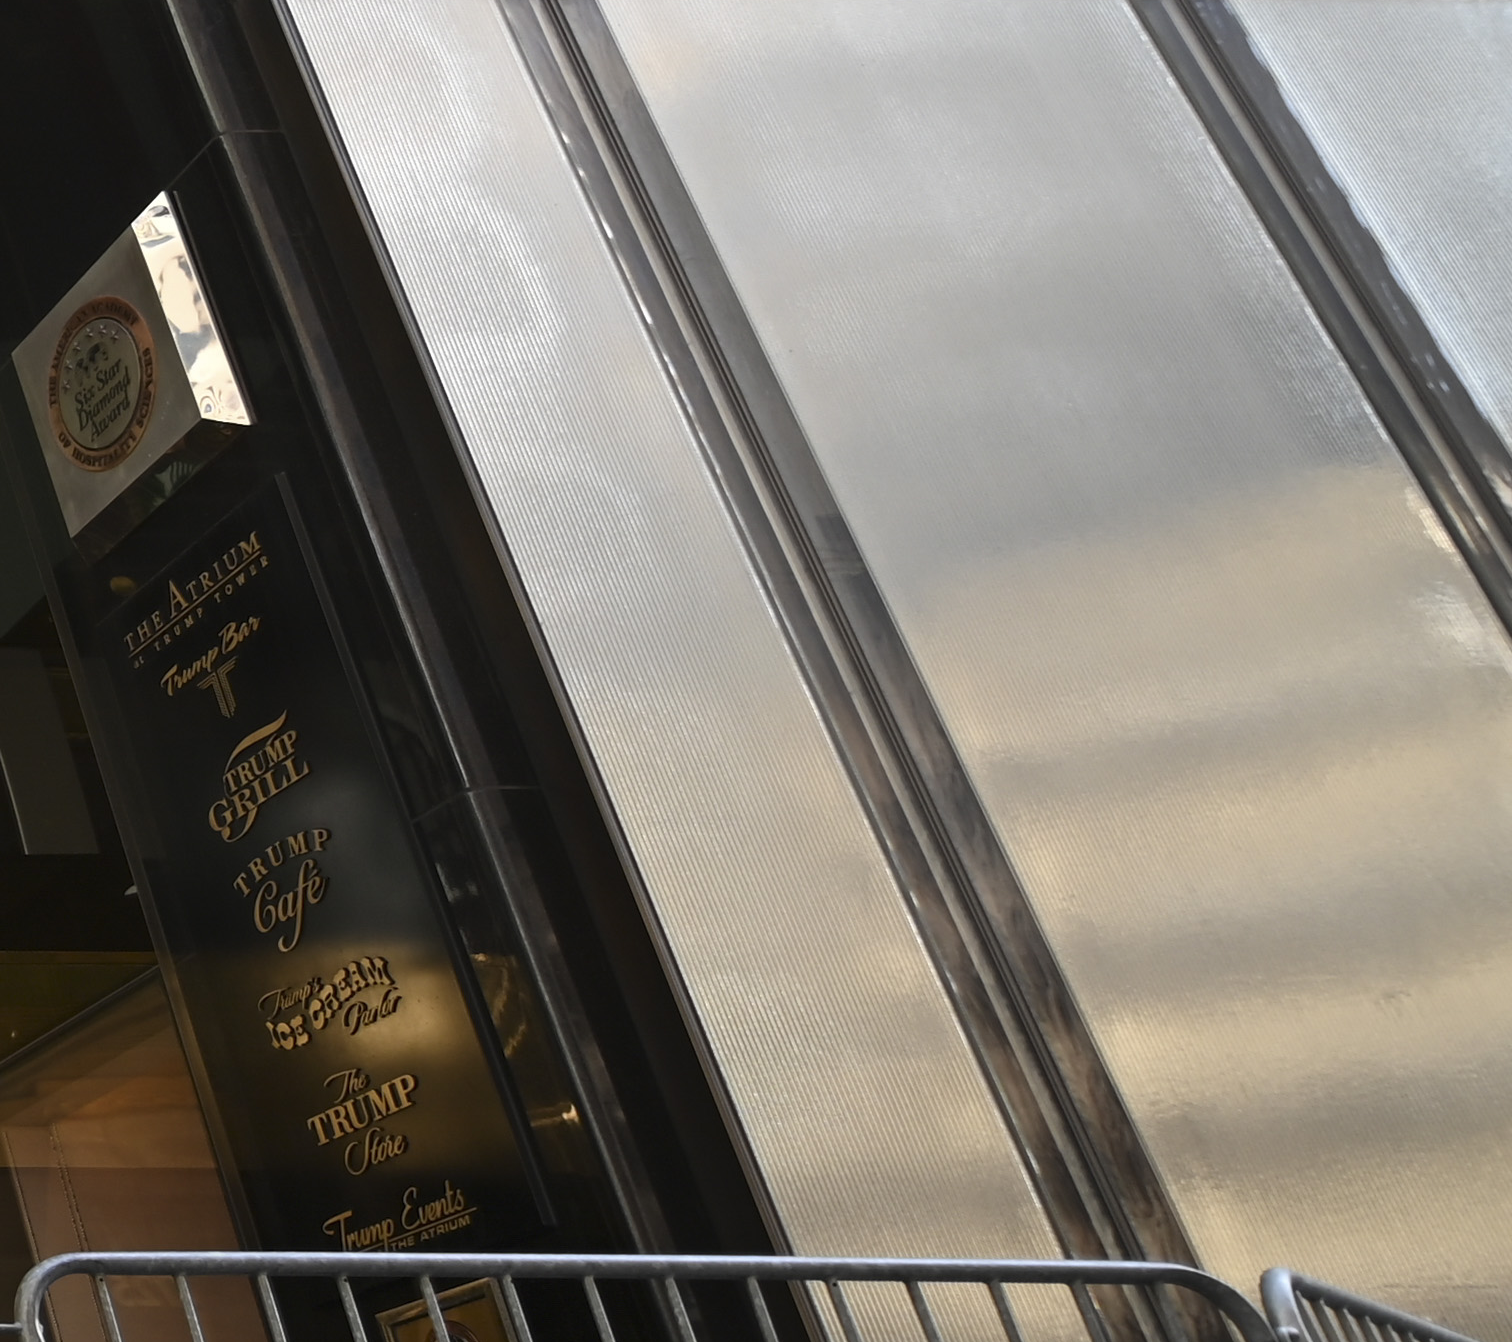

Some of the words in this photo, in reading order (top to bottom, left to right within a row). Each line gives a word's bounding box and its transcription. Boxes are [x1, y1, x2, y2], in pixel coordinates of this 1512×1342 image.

[123, 611, 163, 651] THE
[169, 530, 262, 619] ATRIUM
[154, 607, 203, 651] TRUMP
[214, 556, 269, 603] TOWER
[160, 646, 219, 696] Trump
[218, 616, 261, 655] Bar
[223, 716, 298, 795] TRUMP
[208, 755, 311, 843] GRILL
[232, 828, 330, 898] TRUMP
[253, 858, 327, 953] Café
[258, 977, 323, 1020] Trump's
[265, 1014, 310, 1050] ICE
[309, 956, 395, 1031] CREAM
[342, 987, 402, 1036] Parlor
[307, 1074, 417, 1147] TRUMP
[324, 1068, 366, 1104] The
[344, 1127, 407, 1176] Store
[322, 1210, 395, 1253] Trump
[401, 1179, 466, 1230] Events
[390, 1237, 415, 1252] THE
[420, 1214, 470, 1243] ATRIUM
